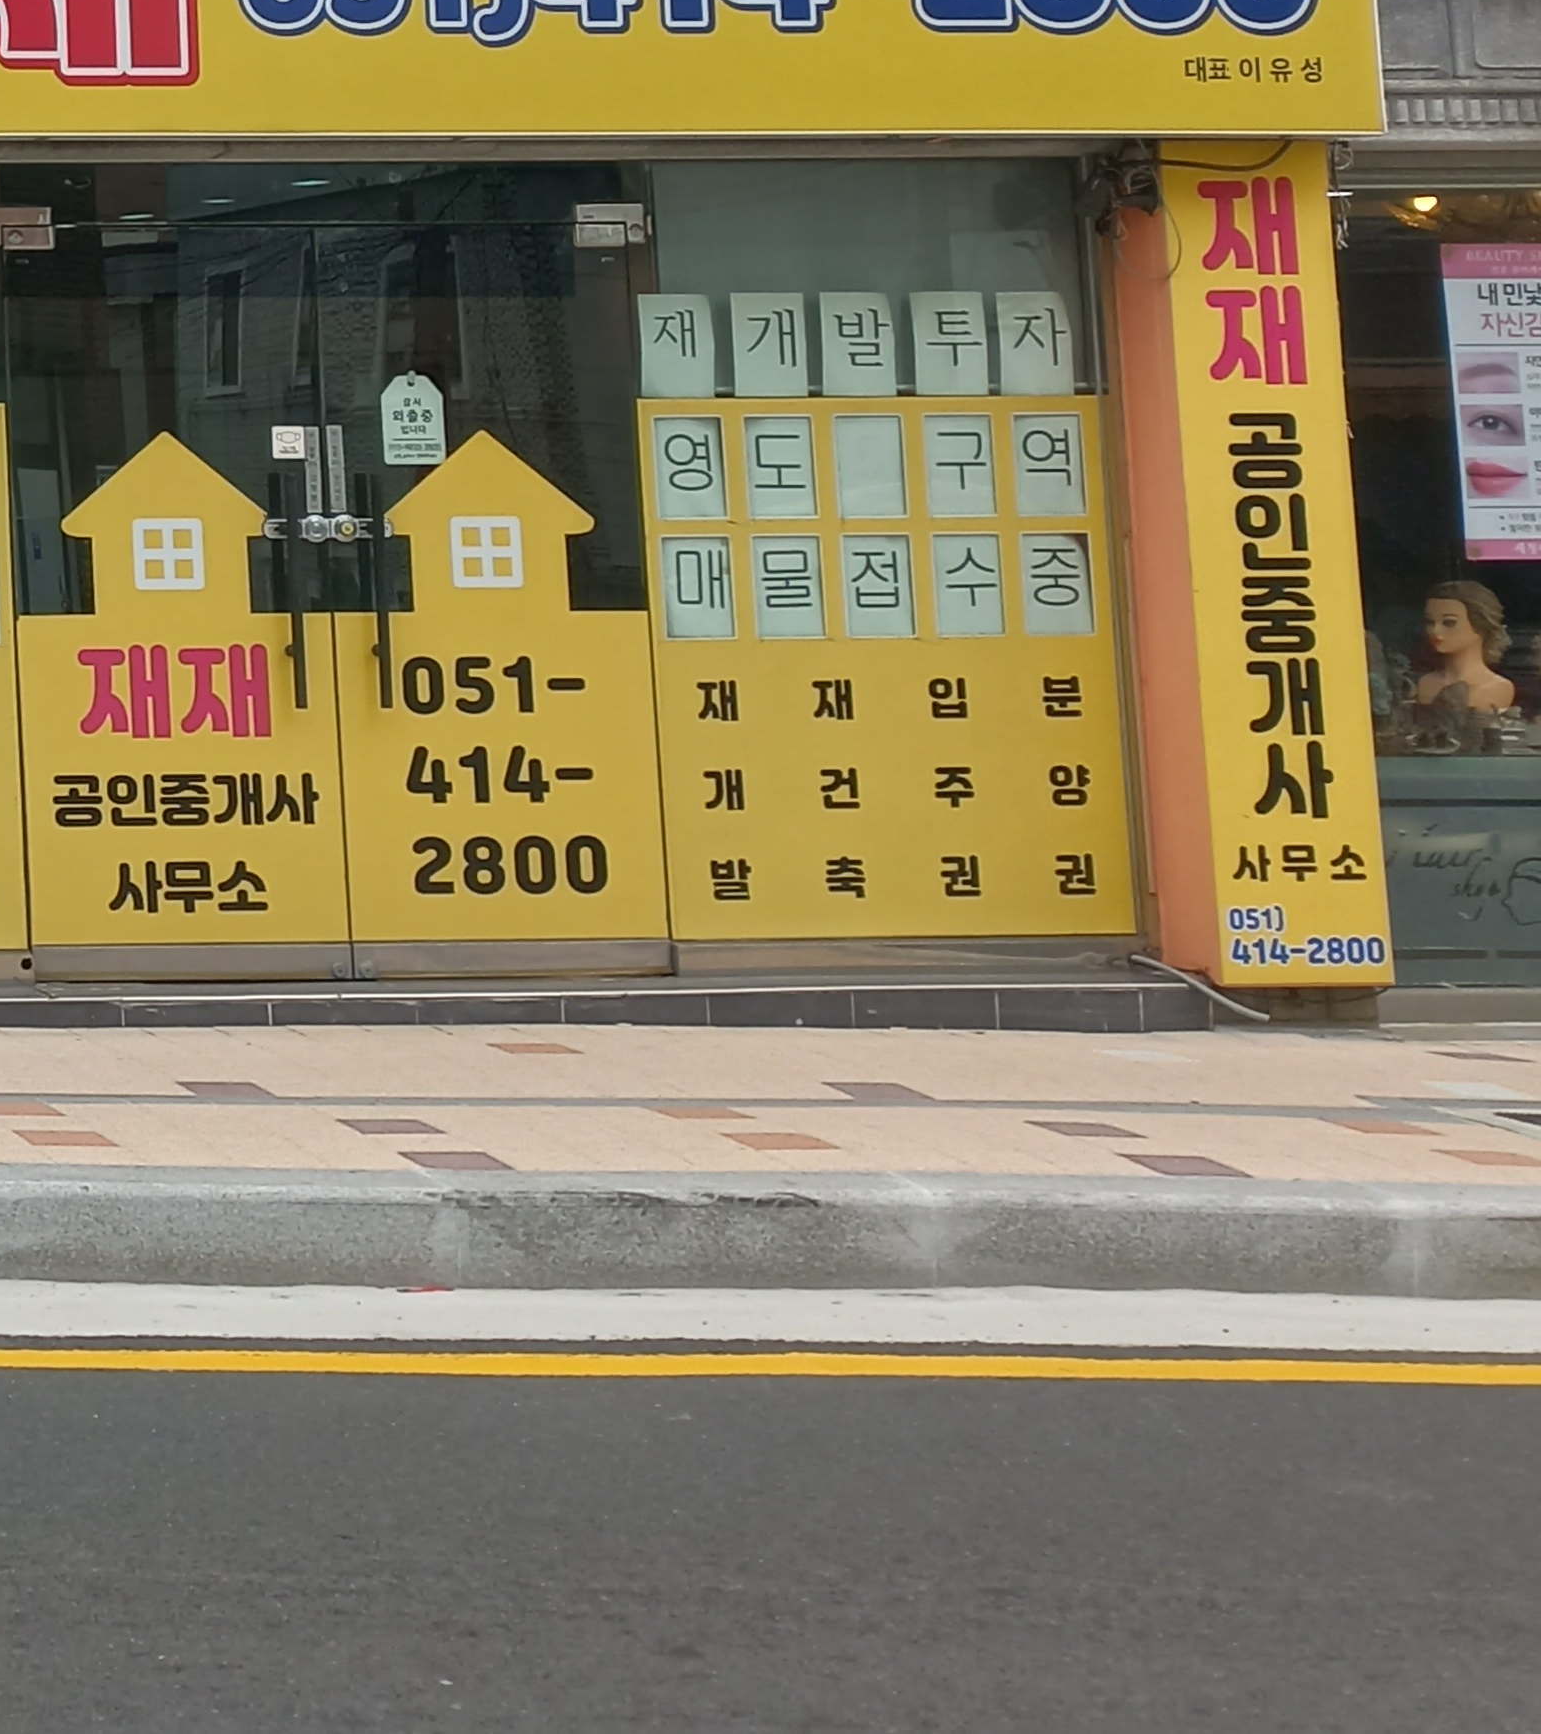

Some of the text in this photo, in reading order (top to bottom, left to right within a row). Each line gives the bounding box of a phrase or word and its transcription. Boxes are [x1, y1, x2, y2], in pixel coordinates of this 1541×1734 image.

[1183, 56, 1233, 84] 대표
[1195, 176, 1309, 386] 재재
[1477, 282, 1500, 307] 내
[662, 427, 1075, 492] 영도 구역
[674, 546, 1083, 610] 매물접수중
[1227, 412, 1335, 820] 공인중개사
[76, 642, 273, 741] 재재
[401, 655, 587, 716] 051-
[51, 771, 321, 828] 공인중개사
[405, 744, 594, 805] 414-
[108, 860, 270, 915] 사무소
[411, 834, 609, 895] 2800
[1231, 843, 1368, 883] 사무소
[1228, 906, 1286, 934] 051)
[1230, 936, 1386, 966] 414-2800
